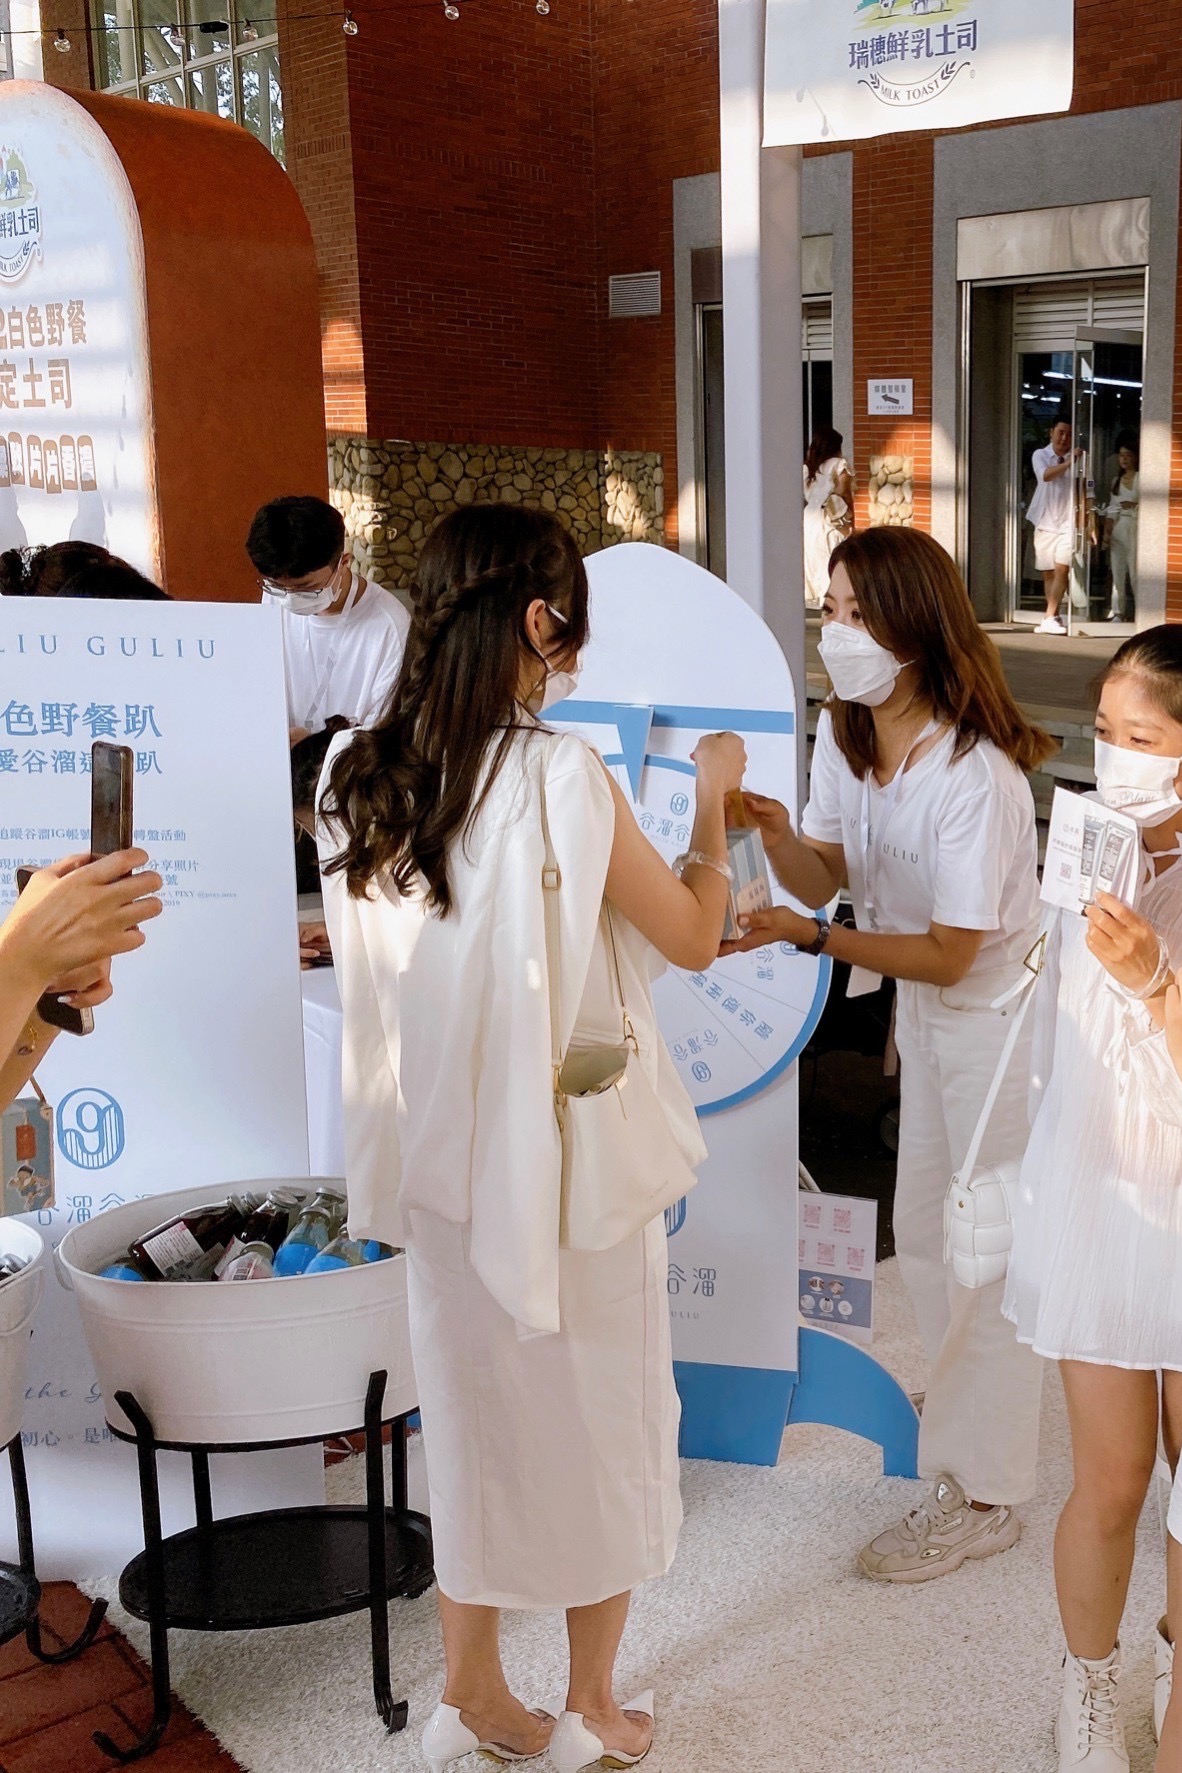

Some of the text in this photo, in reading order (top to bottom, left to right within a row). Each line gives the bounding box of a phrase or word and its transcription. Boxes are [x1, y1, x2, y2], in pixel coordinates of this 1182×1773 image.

[848, 19, 978, 70] 瑞穗鮮乳土司
[880, 79, 940, 101] MILK TOAST
[87, 636, 215, 659] GULIU
[0, 699, 163, 739] 色野餐趴
[882, 843, 919, 864] ULIU
